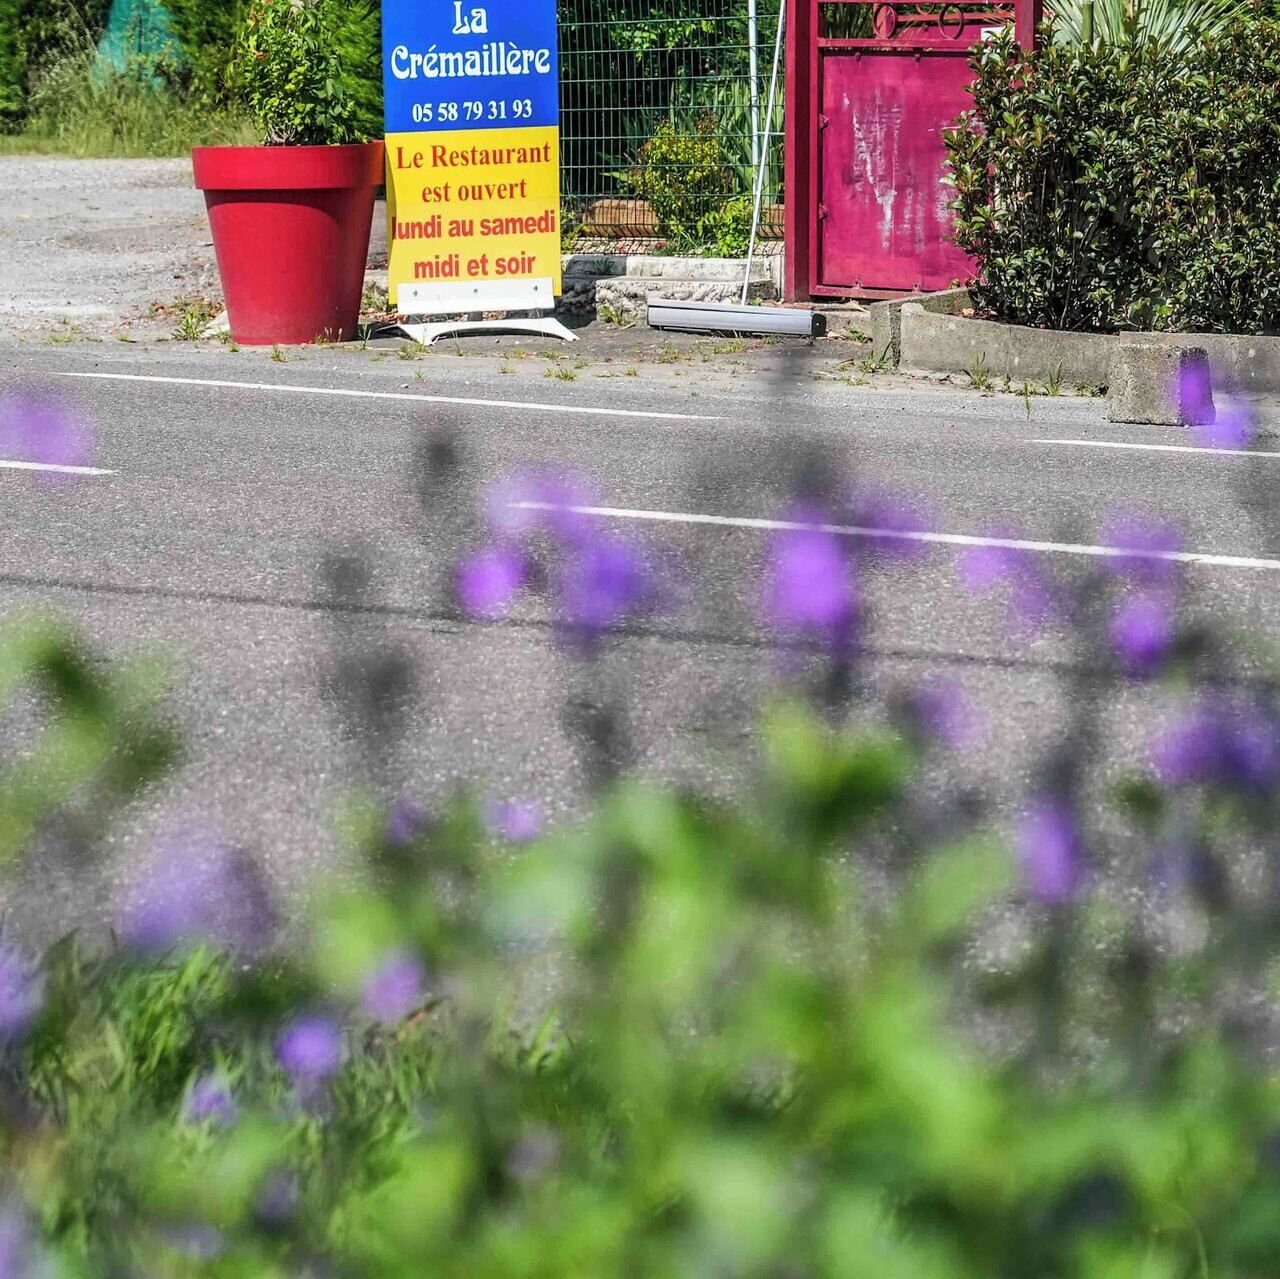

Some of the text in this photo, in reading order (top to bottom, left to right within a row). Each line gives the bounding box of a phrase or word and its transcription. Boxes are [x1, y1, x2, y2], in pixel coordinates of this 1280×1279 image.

[451, 0, 488, 35] La
[390, 41, 551, 80] Crémaillère
[412, 99, 532, 123] 05 58 79 31 93
[395, 141, 552, 169] Le Restaurant
[421, 177, 527, 203] est ouvert
[391, 209, 556, 240] lundi au samedi
[414, 251, 537, 279] midi et soir
